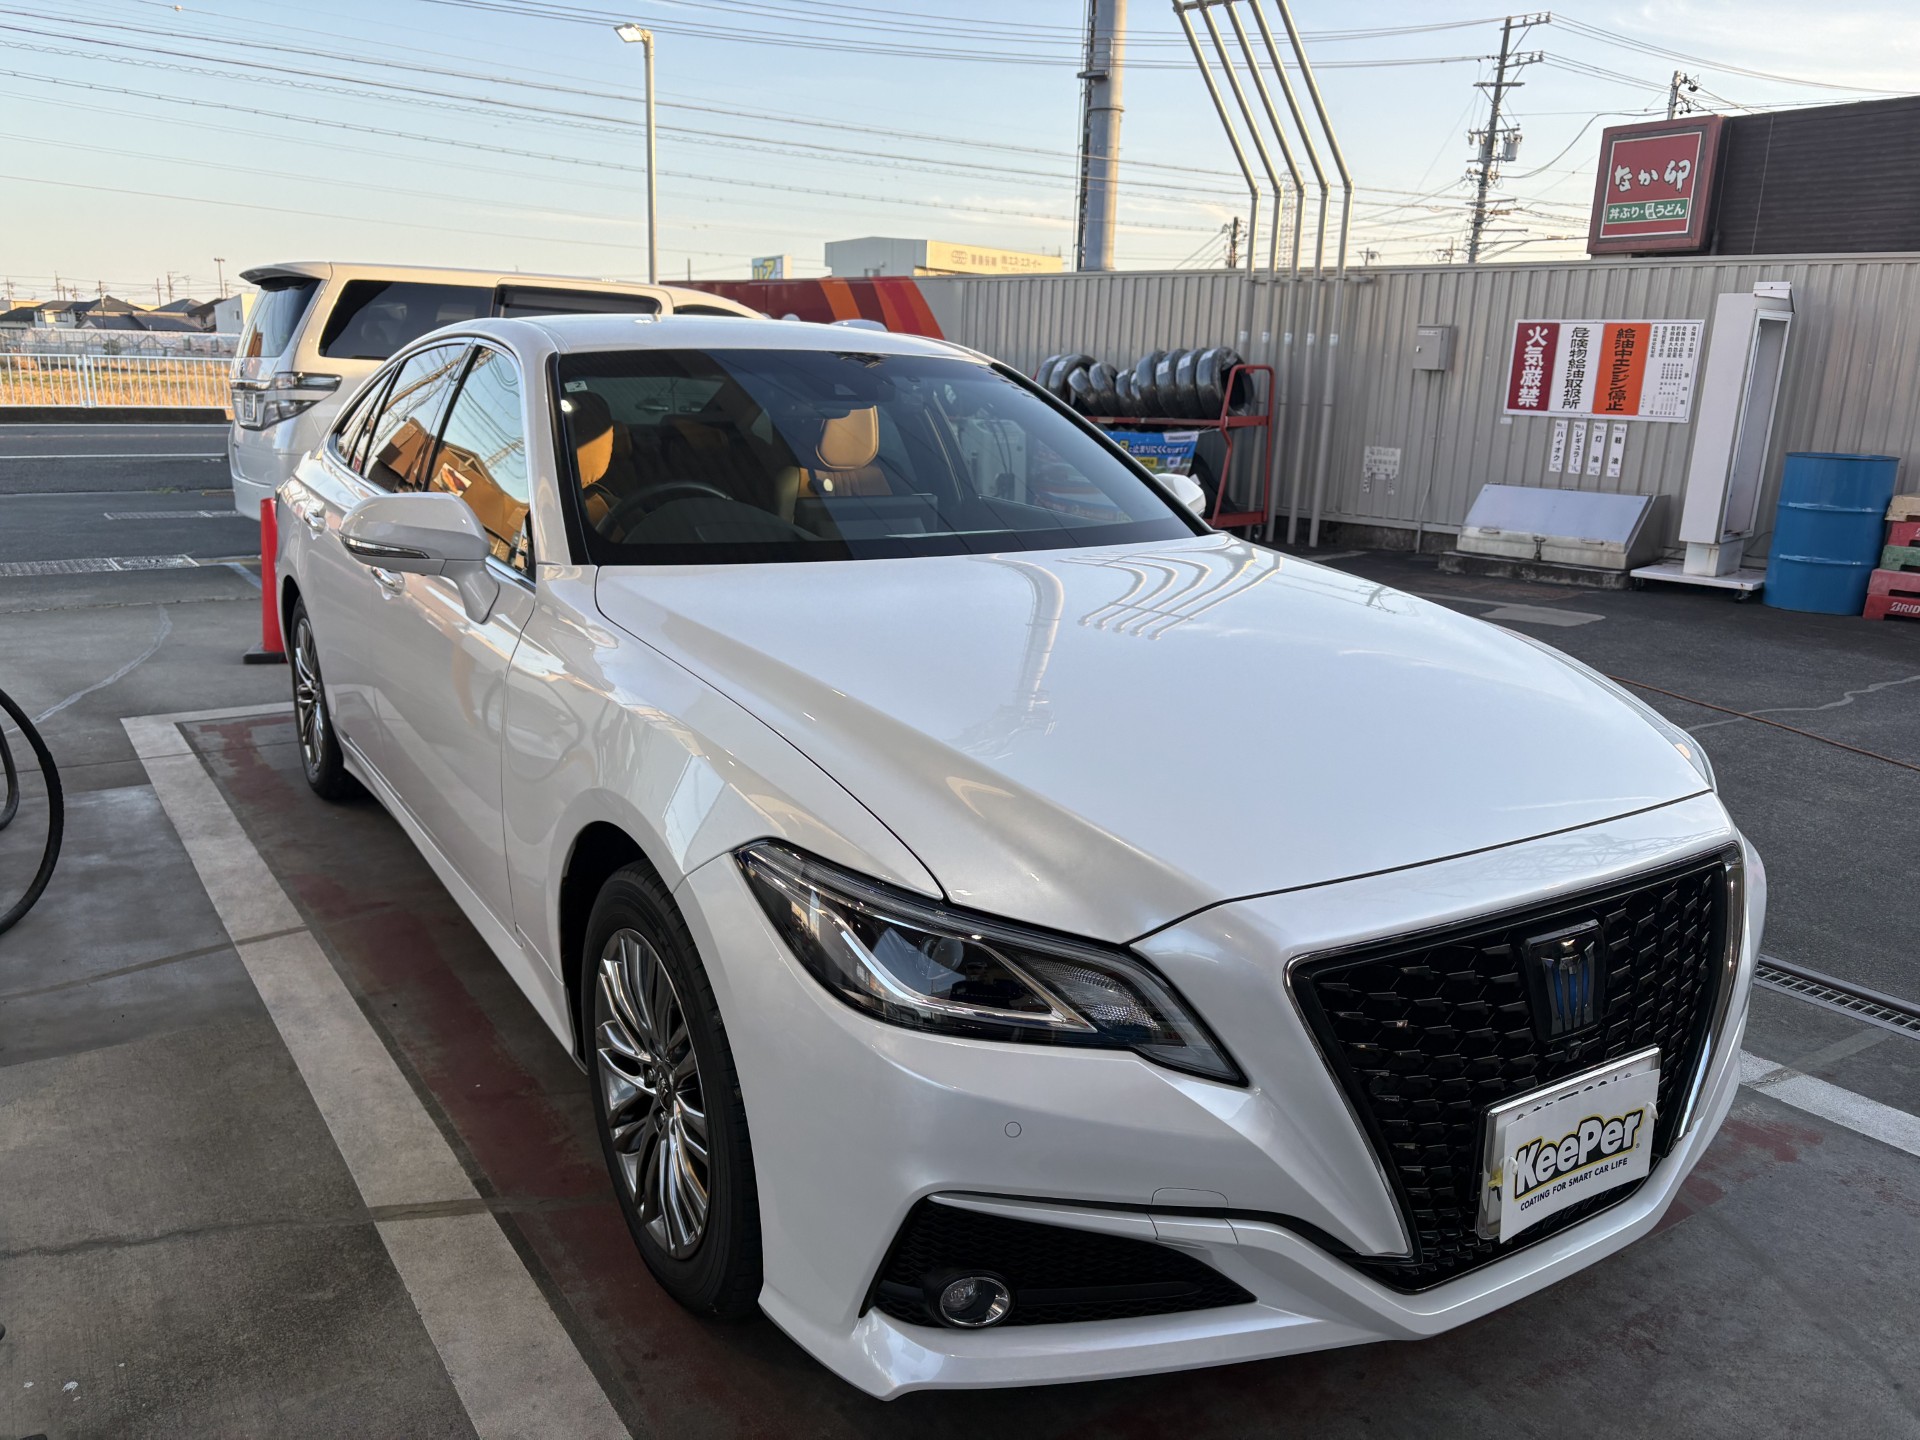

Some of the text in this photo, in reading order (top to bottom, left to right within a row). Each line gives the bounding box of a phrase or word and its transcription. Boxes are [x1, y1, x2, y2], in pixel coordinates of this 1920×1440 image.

[1614, 159, 1691, 192] なか卯
[1517, 326, 1548, 407] 火気厳禁
[1562, 327, 1590, 409] 危険物給油取扱所
[1605, 328, 1636, 411] 給油中エンジン停止
[1553, 431, 1564, 461] ハイオク
[1573, 431, 1583, 464] レギュラー
[1515, 1109, 1645, 1200] KeePer
[1520, 1157, 1628, 1211] COATING FOR SMART CAR LIFE
